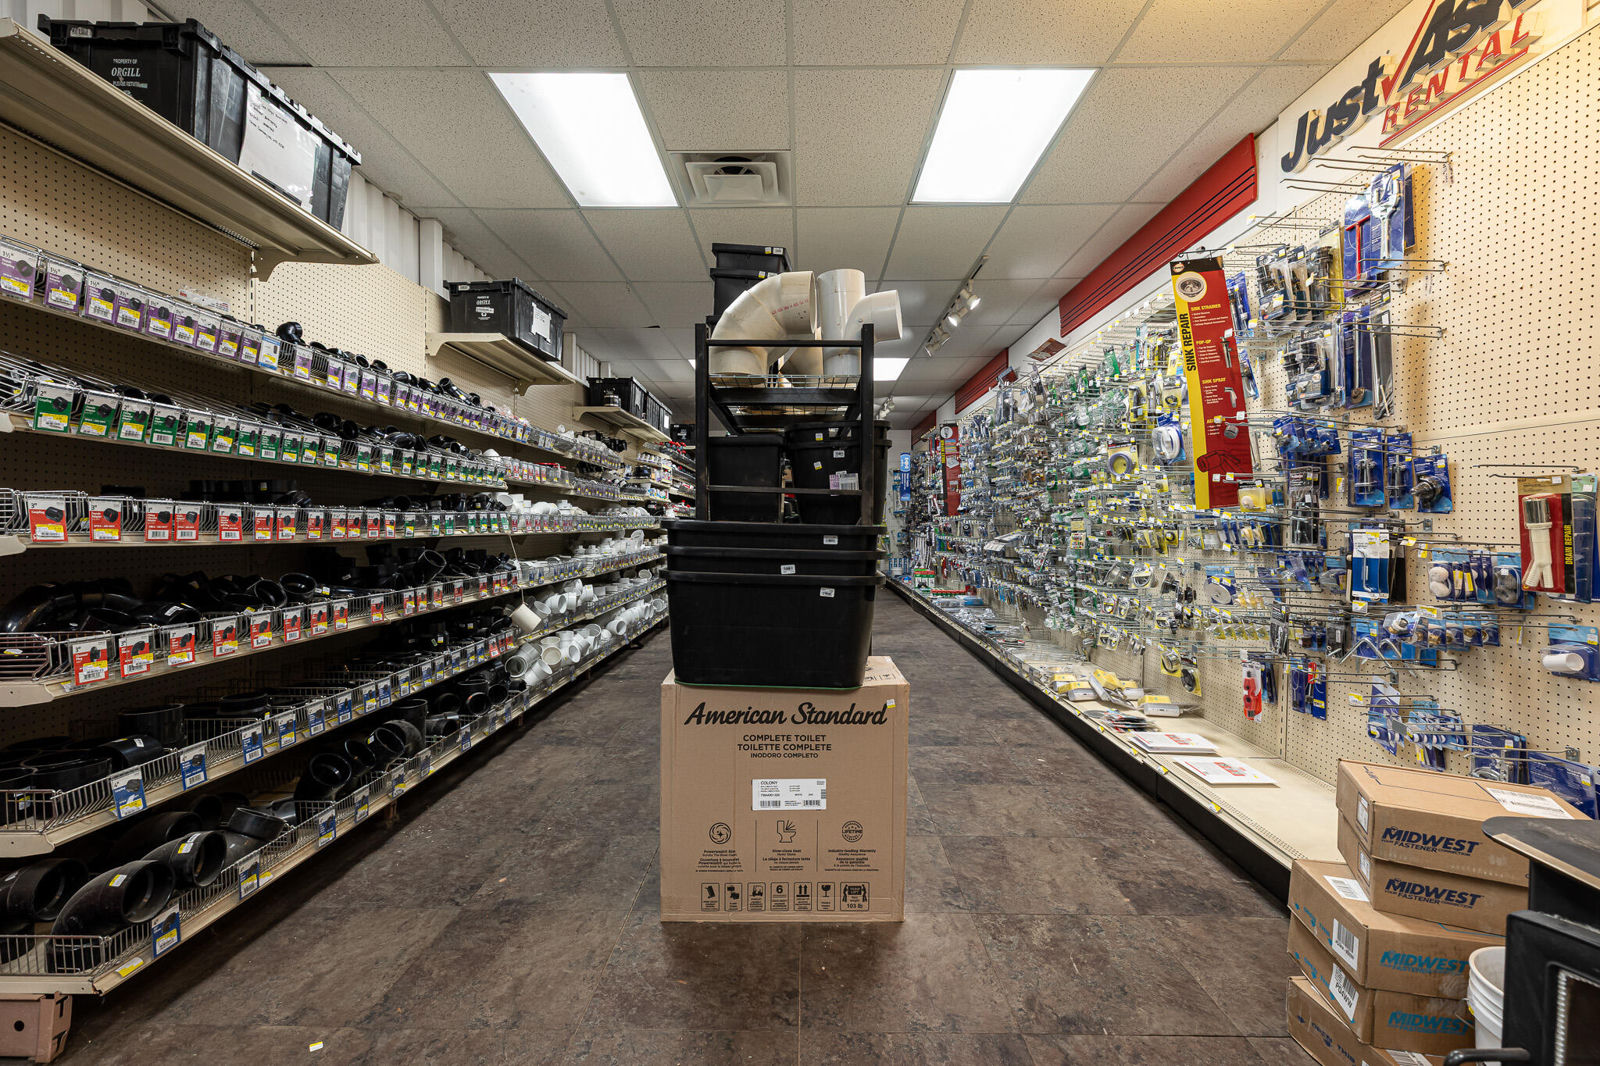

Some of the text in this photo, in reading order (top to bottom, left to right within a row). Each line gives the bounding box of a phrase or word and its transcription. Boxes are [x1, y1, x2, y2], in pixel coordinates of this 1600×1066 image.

[111, 67, 141, 77] ORGILL
[1381, 13, 1530, 135] RENTAL
[1281, 55, 1385, 173] Just
[1179, 313, 1196, 371] SINK REPAIR
[1564, 525, 1573, 565] DRAIN REPAIR
[684, 702, 888, 726] American Standard
[743, 734, 826, 742] COMPLETE TOILET
[1382, 827, 1480, 853] MIDWEST
[1394, 842, 1438, 853] FASTENER
[776, 884, 784, 894] 6
[1385, 879, 1482, 906] MIDWEST
[1398, 892, 1441, 905] FASTENER
[1380, 950, 1469, 974] MIDWEST
[1388, 1010, 1474, 1035] MIDWEST
